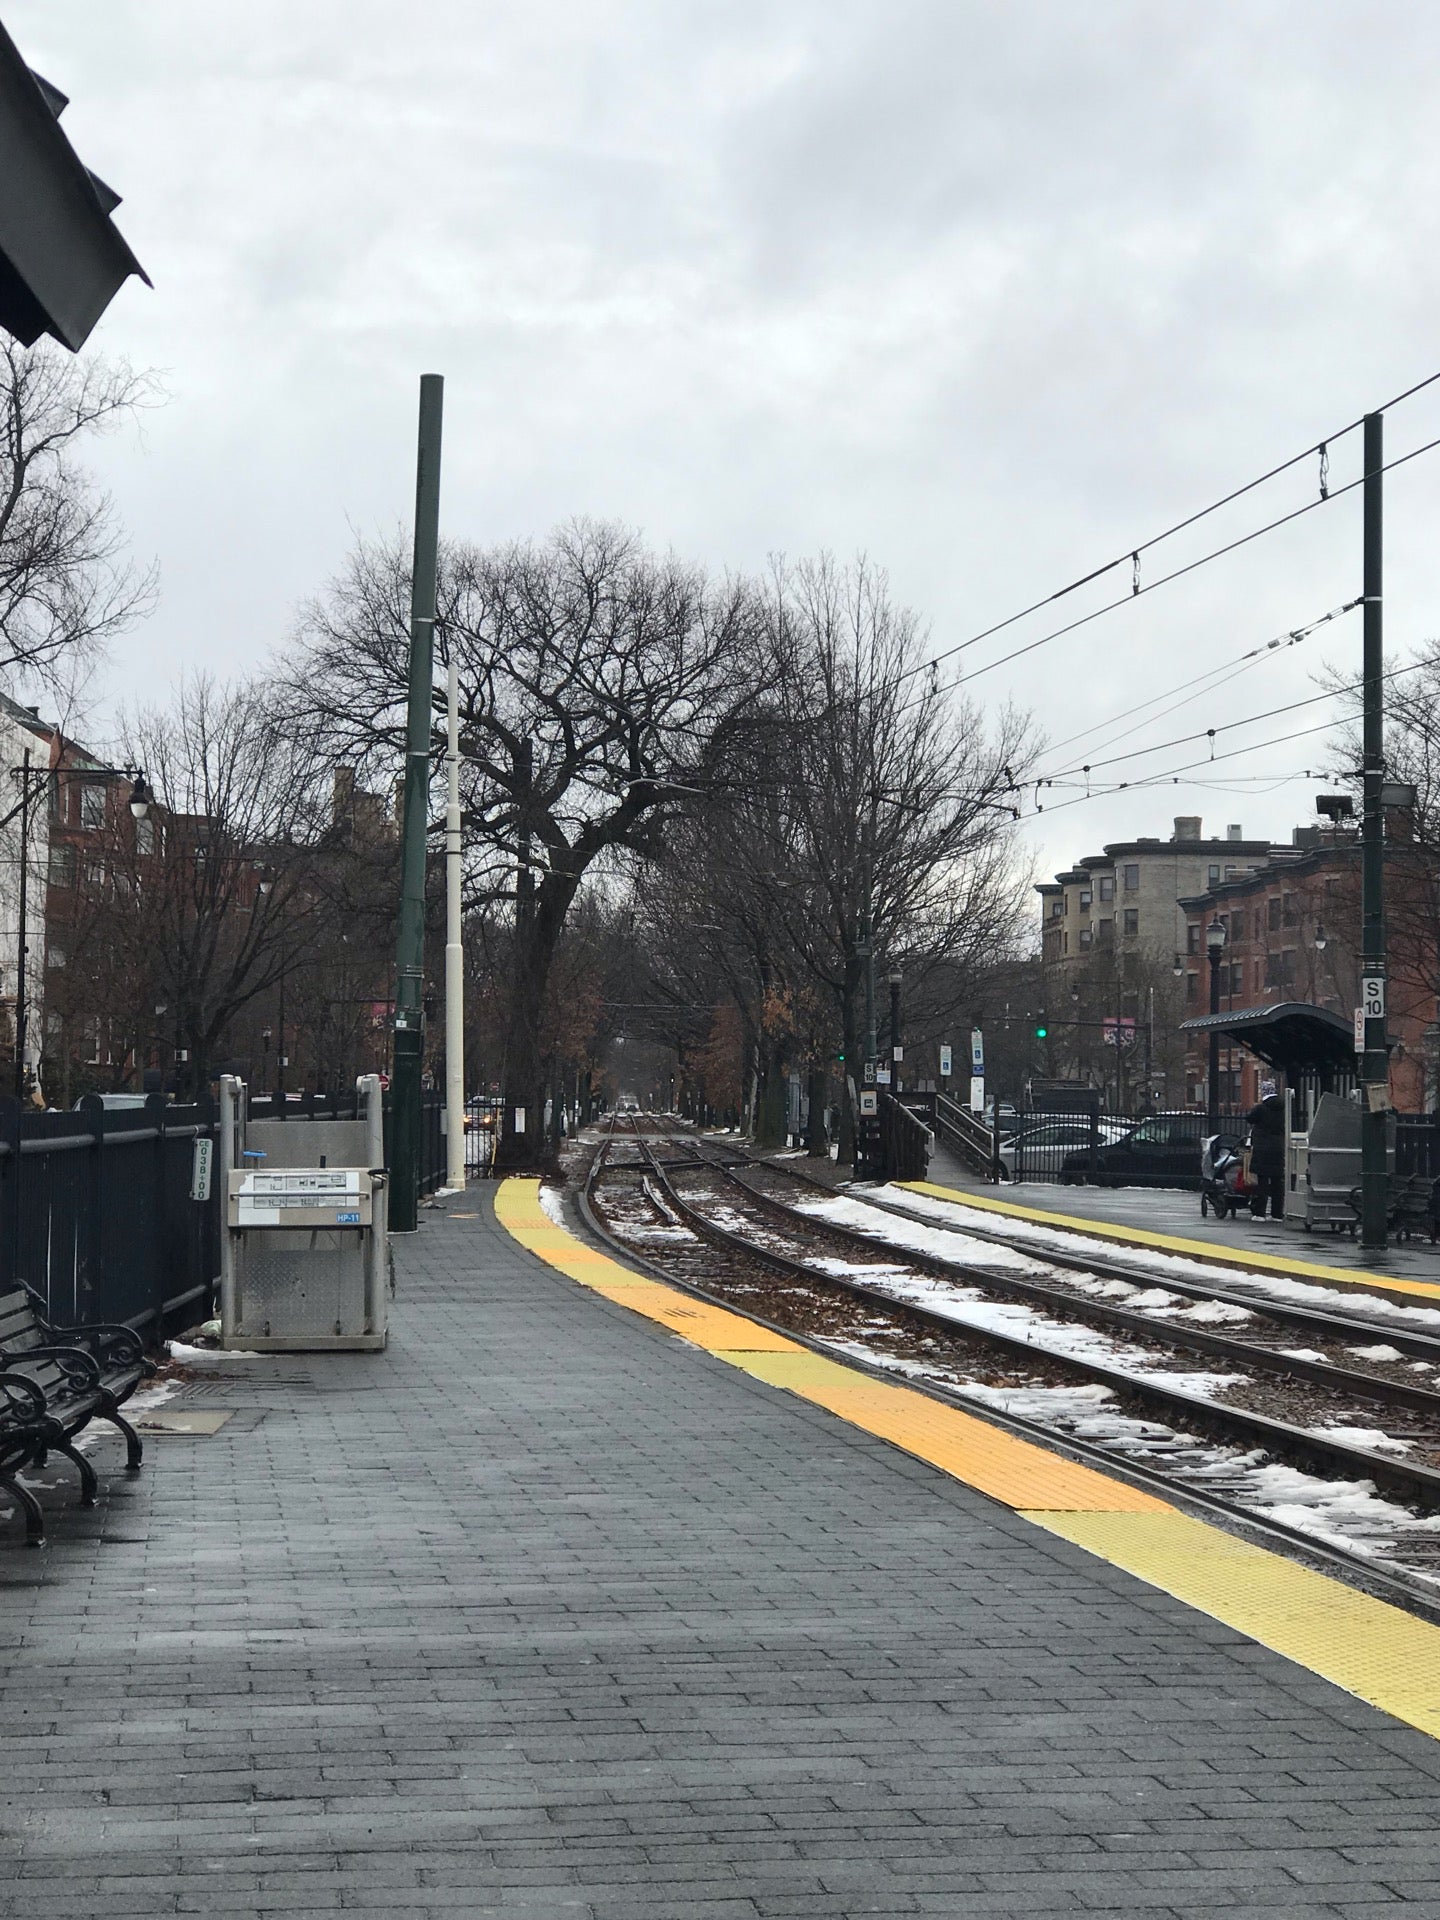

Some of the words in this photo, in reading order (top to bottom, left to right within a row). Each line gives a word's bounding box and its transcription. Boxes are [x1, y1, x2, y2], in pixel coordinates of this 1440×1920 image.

[1367, 982, 1379, 997] S
[1365, 1000, 1381, 1015] 10
[337, 1214, 359, 1222] HP-11
